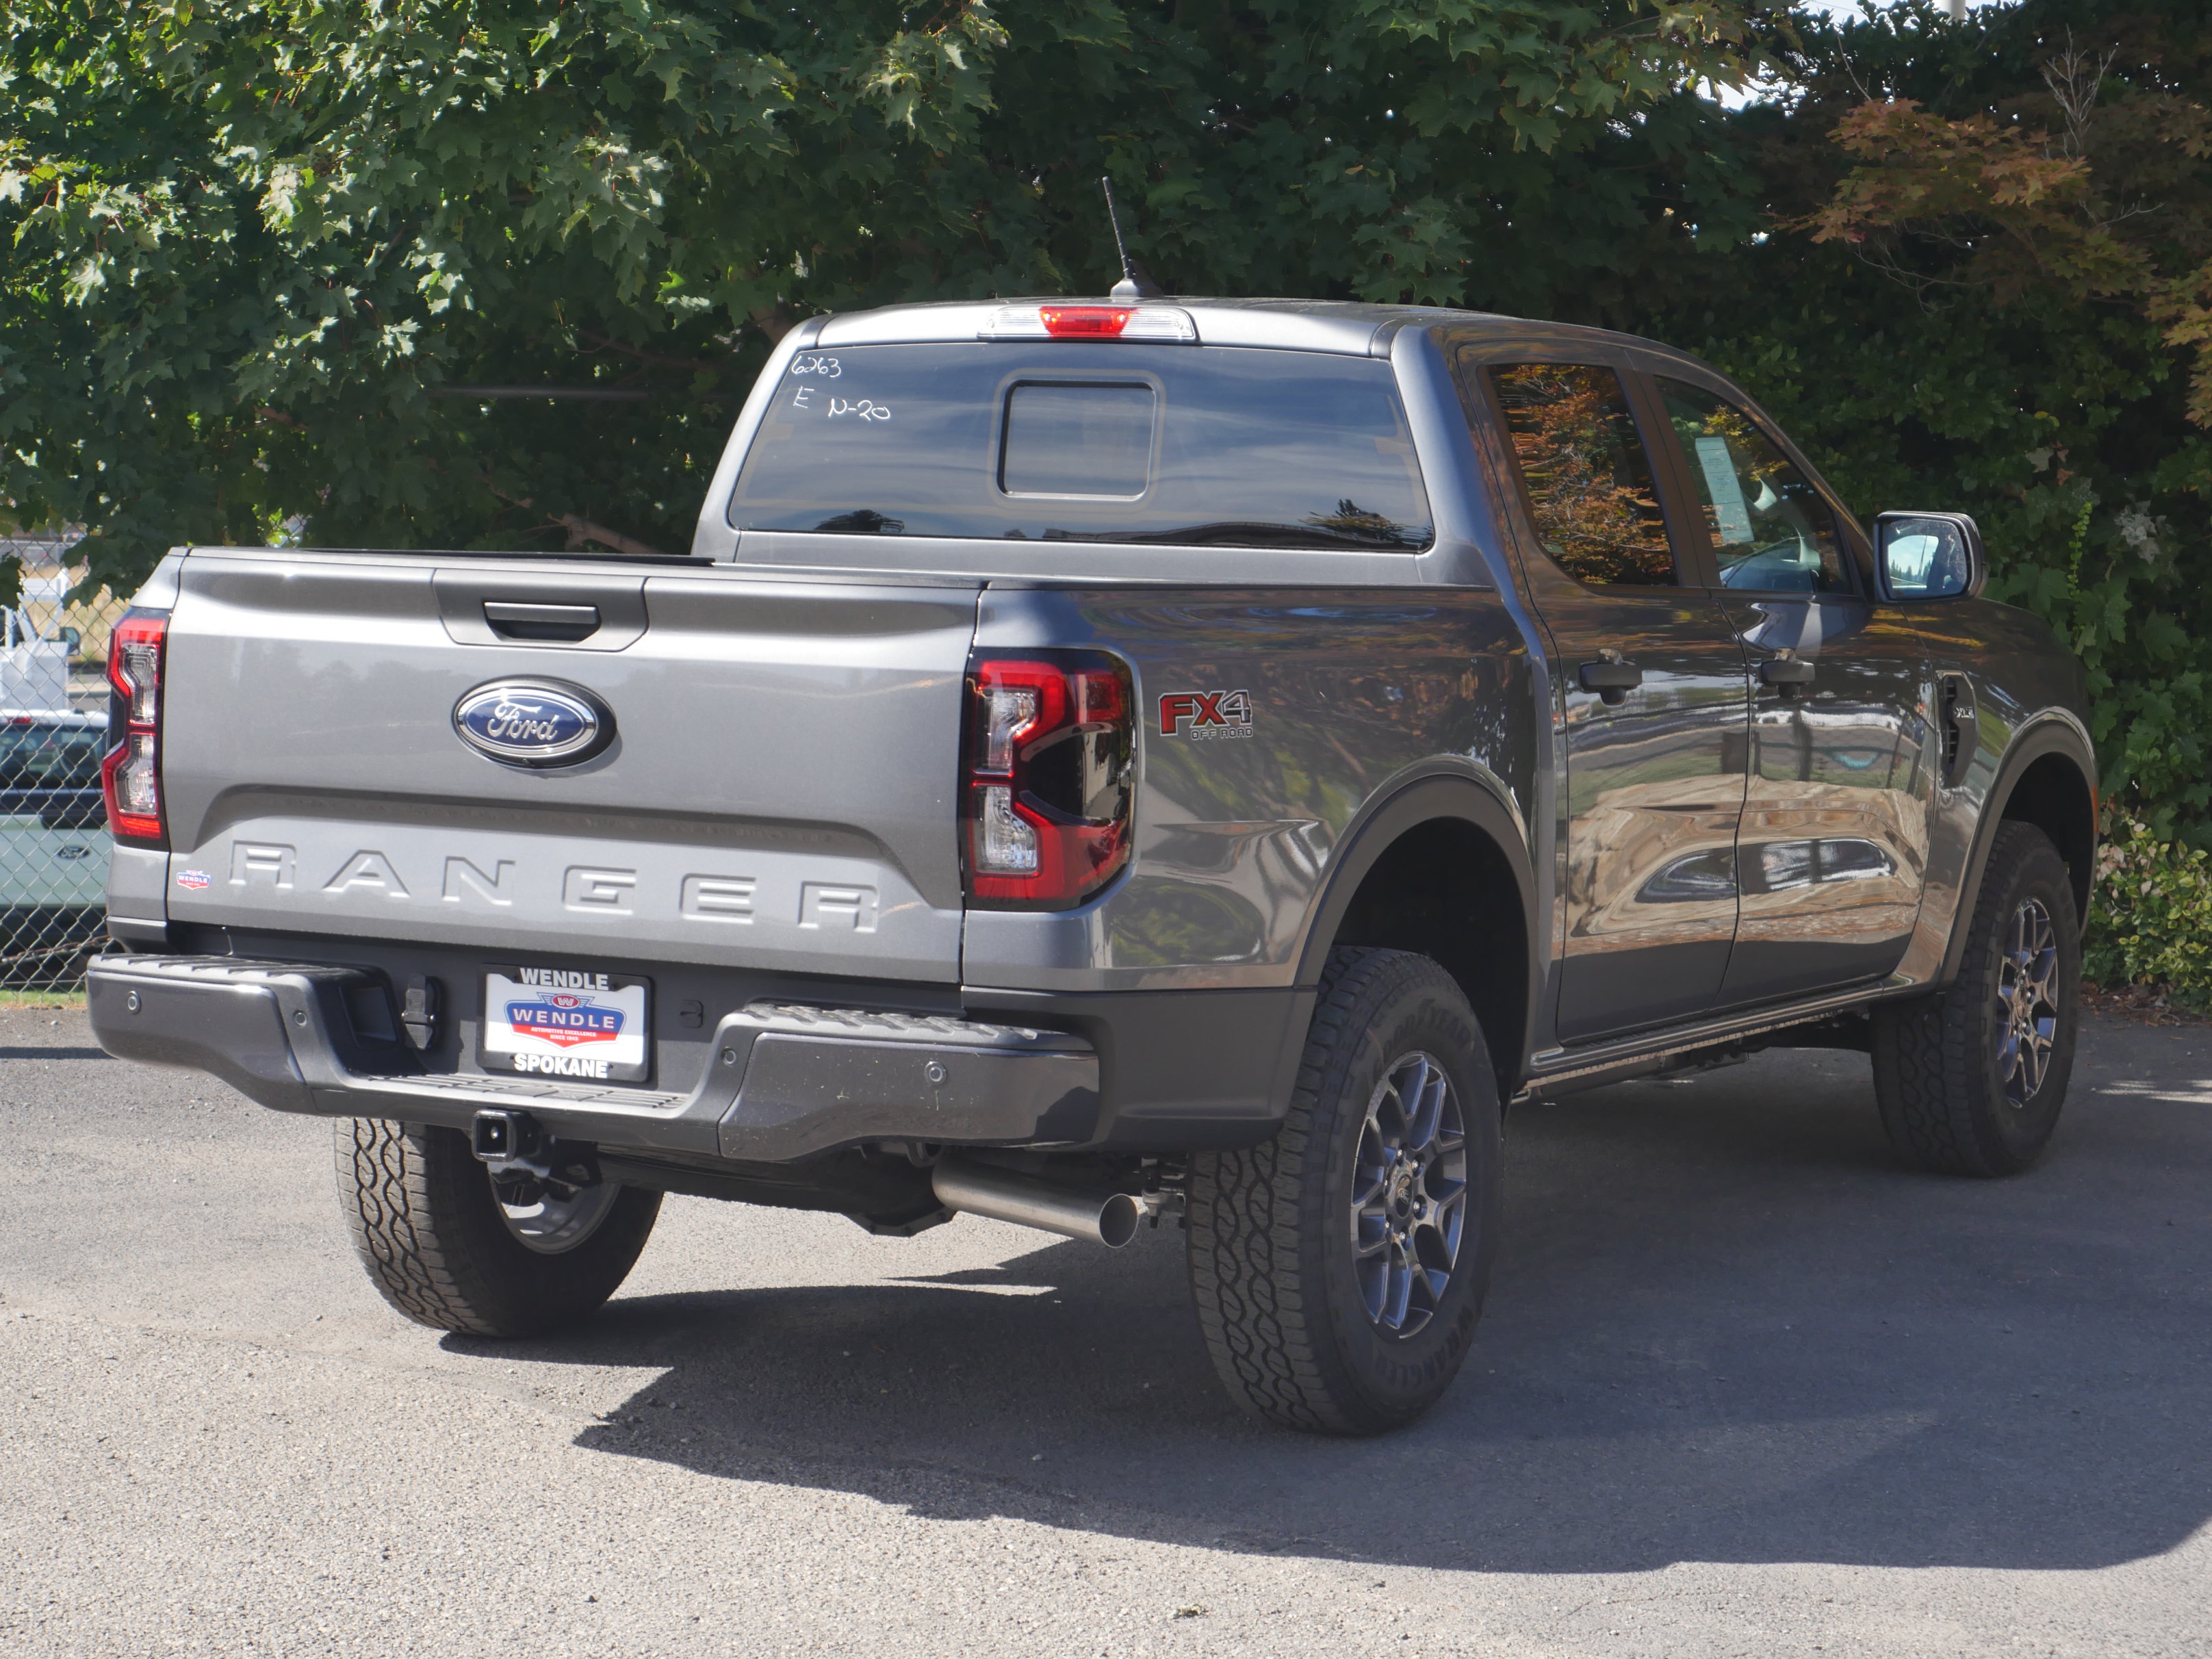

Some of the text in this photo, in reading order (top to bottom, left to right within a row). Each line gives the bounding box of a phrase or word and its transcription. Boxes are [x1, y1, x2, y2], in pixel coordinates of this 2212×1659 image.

[487, 702, 560, 738] Ford
[1159, 690, 1252, 736] FX4
[1191, 728, 1253, 741] OFF ROAD
[229, 840, 880, 934] RANGER
[519, 967, 609, 990] WENDLE
[513, 1008, 615, 1029] WENDLE
[514, 1053, 608, 1079] SPOKANE
